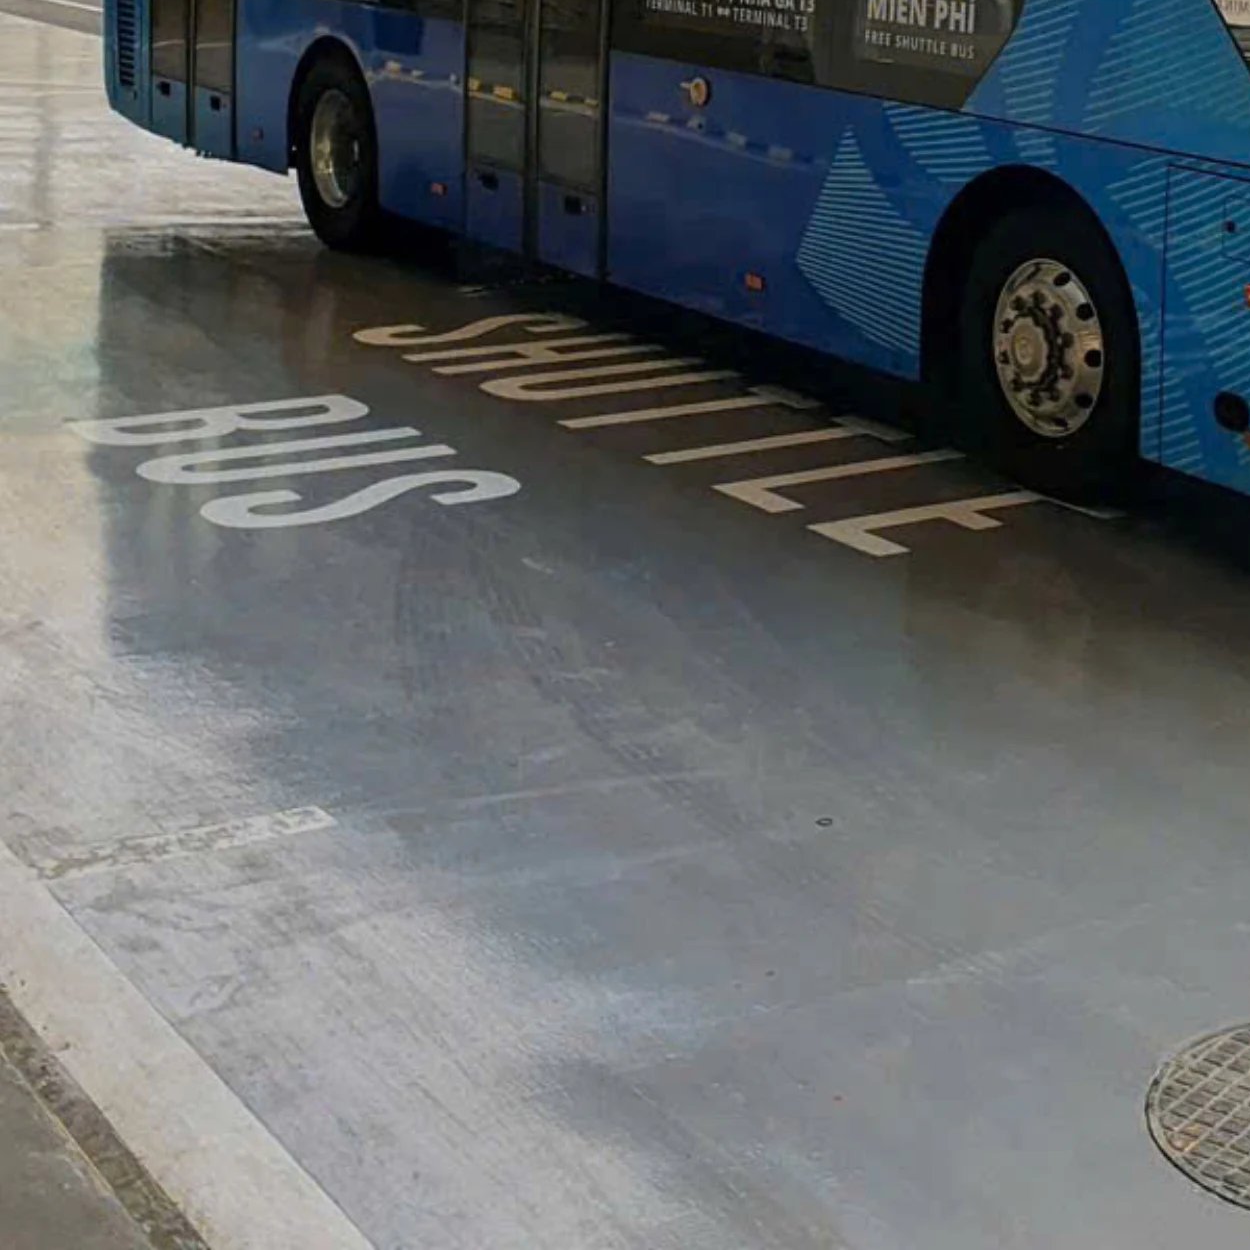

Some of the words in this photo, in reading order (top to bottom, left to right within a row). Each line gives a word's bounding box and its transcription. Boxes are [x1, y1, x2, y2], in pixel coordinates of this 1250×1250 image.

[702, 1, 713, 18] T1
[732, 6, 791, 31] TERMINAL
[794, 15, 808, 32] T3
[865, 29, 892, 47] FREE
[895, 34, 948, 56] SHUTTLE
[950, 42, 975, 60] BUS
[65, 394, 522, 530] BUS
